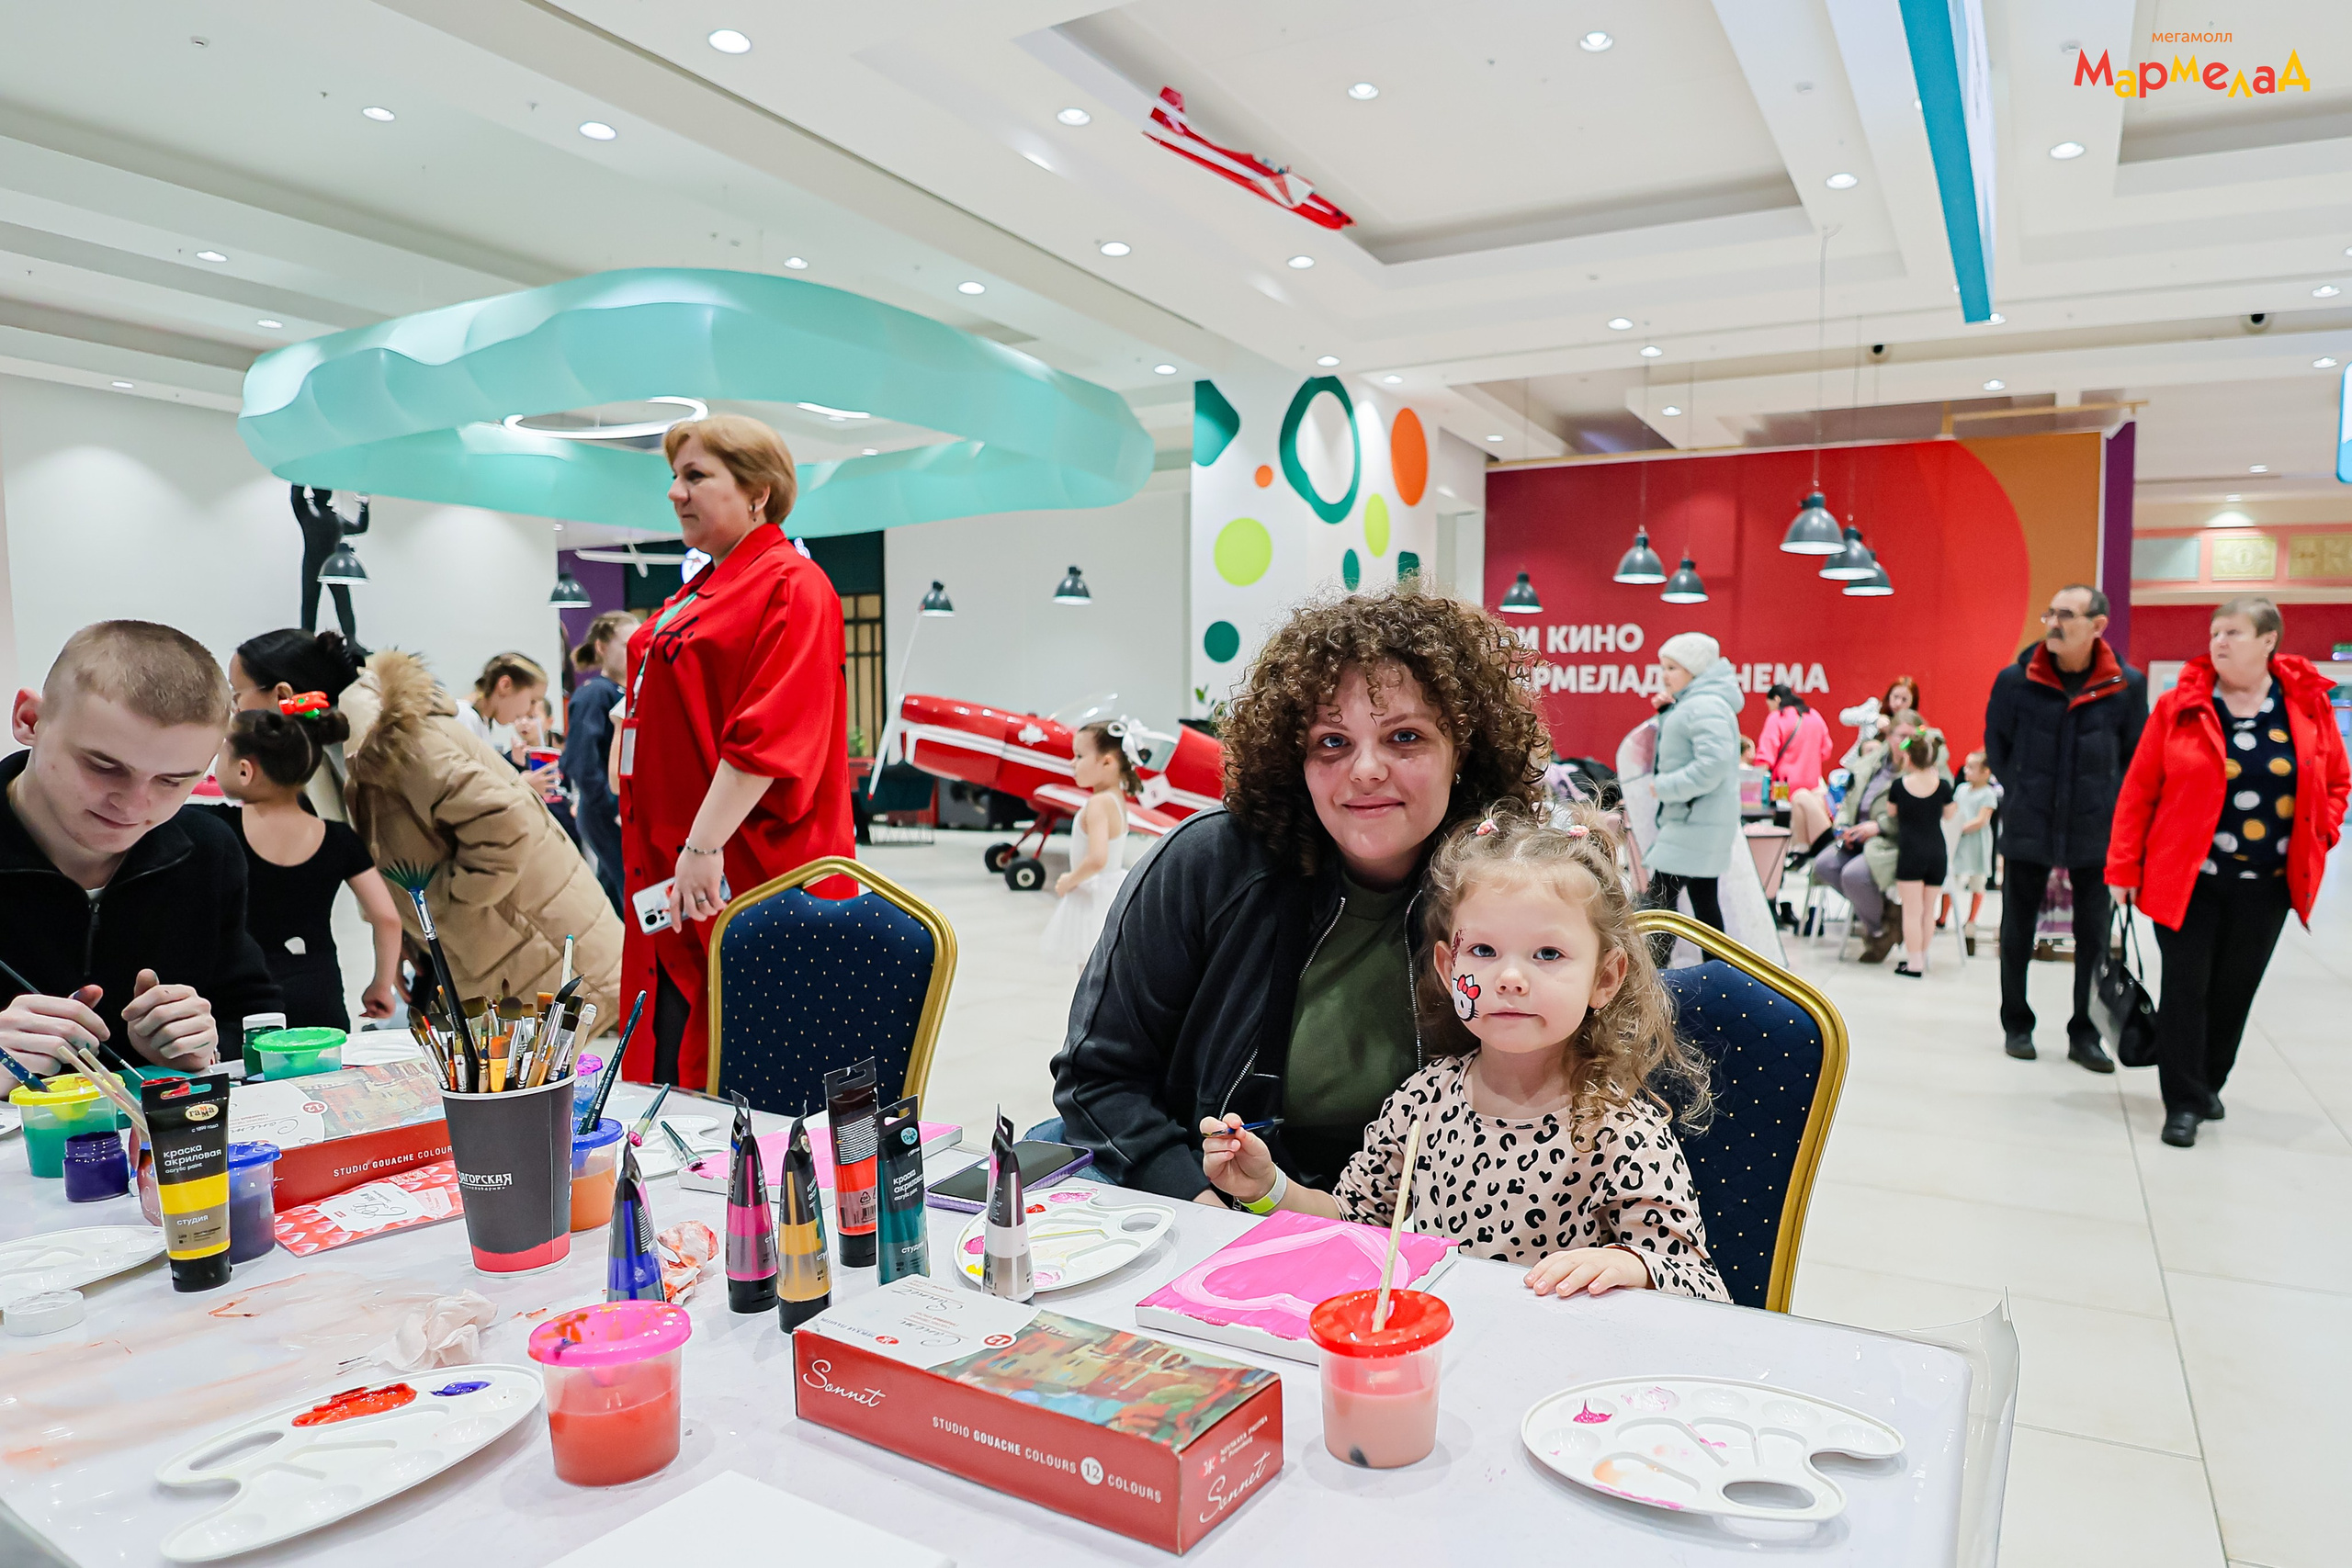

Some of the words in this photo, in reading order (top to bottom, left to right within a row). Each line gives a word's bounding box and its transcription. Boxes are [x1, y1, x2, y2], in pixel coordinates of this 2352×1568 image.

[1546, 623, 1645, 653] КИНО
[1733, 662, 1830, 694] НЕМА
[163, 1145, 202, 1159] краска
[164, 1149, 222, 1167] акриловая
[334, 1163, 368, 1177] STUDIO
[372, 1153, 414, 1168] GOUACHE
[417, 1145, 453, 1159] COLOUR
[176, 1214, 209, 1226] студия
[802, 1359, 887, 1408] Sonnet
[932, 1416, 970, 1438] STUDIO
[973, 1429, 1022, 1456] GOUACHE
[1024, 1447, 1077, 1474] COLOURS
[1083, 1462, 1101, 1481] 12
[1107, 1473, 1162, 1504] COLOURS
[1199, 1450, 1272, 1524] Sonnet
